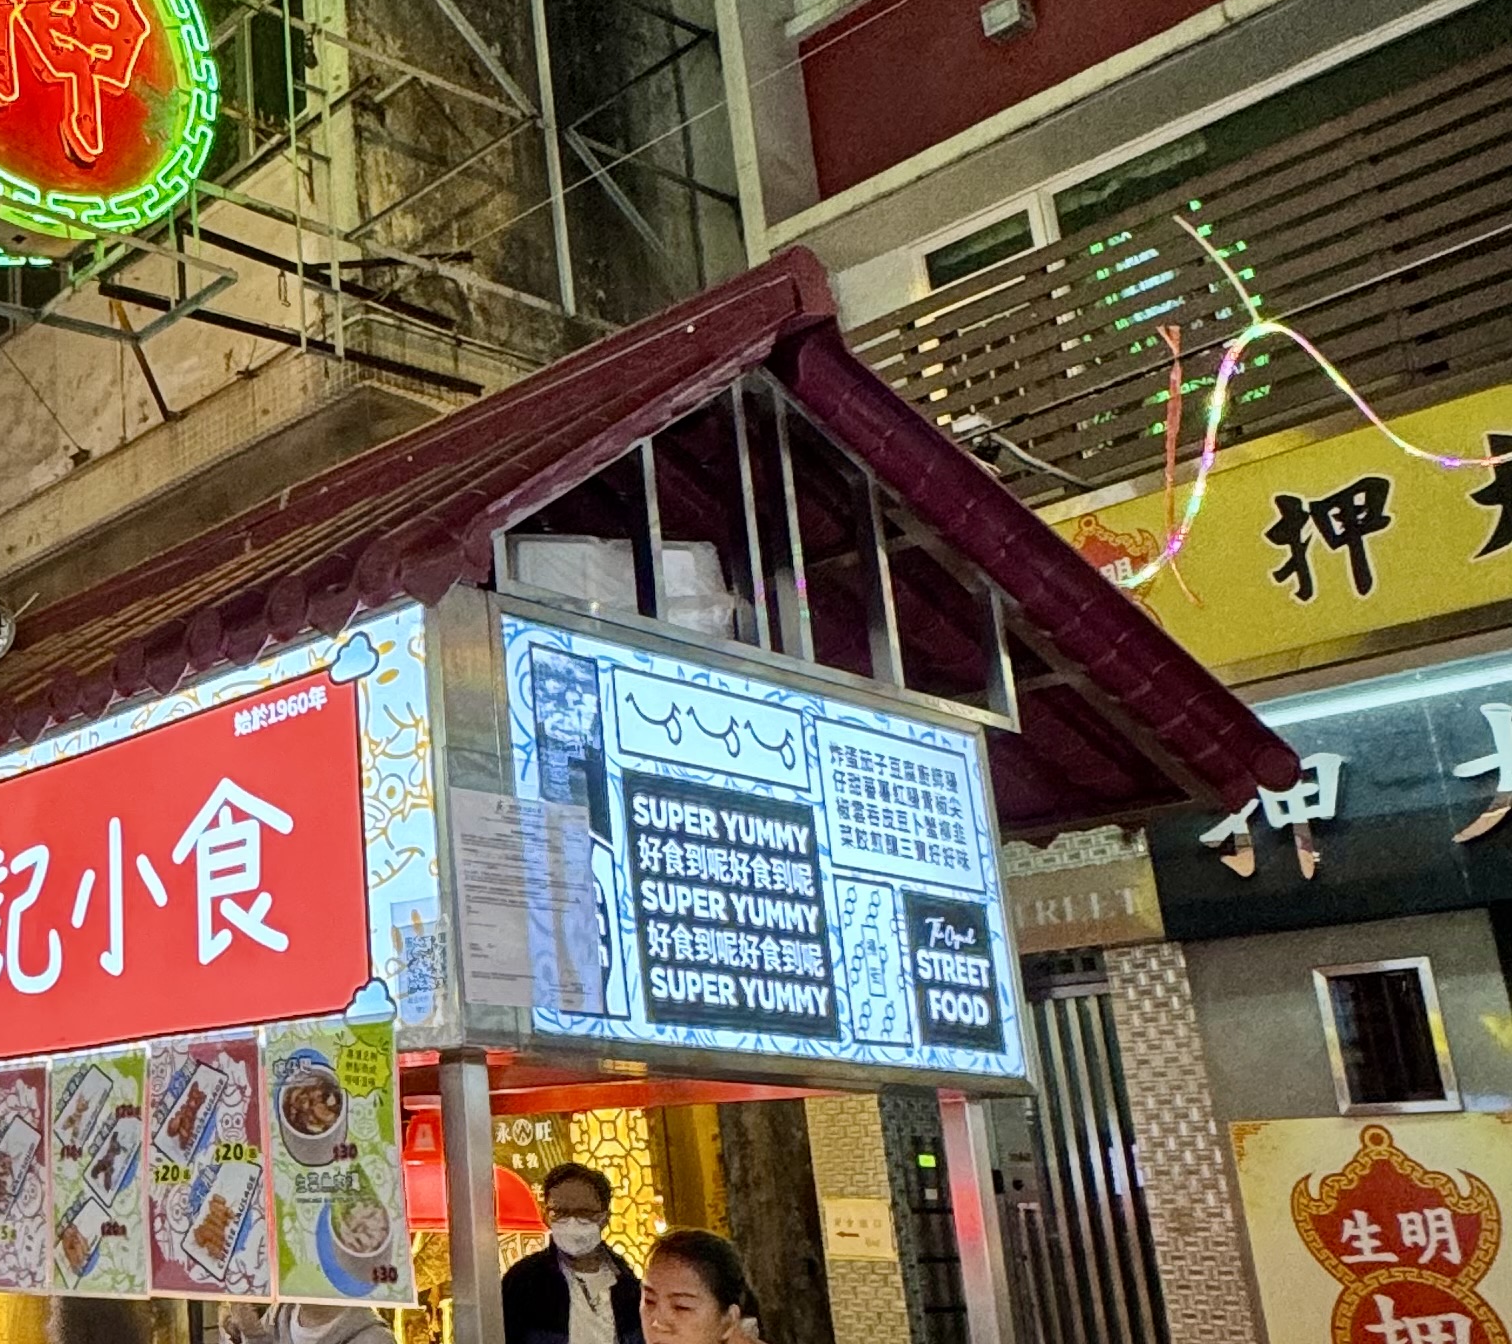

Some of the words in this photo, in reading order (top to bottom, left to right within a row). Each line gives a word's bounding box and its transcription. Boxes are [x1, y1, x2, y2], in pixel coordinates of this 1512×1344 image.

[234, 685, 327, 736] 始於1960年
[633, 794, 719, 839] SUPER
[720, 810, 809, 854] YUMMY
[637, 833, 816, 897] 好食到呢好食到呢
[641, 880, 729, 921] SUPER
[730, 892, 819, 934] YUMMY
[647, 919, 825, 978] 好食到呢好食到呢
[916, 948, 991, 989] STREET
[650, 966, 739, 1007] SUPER
[739, 976, 829, 1017] YUMMY
[927, 988, 990, 1027] FOOD
[155, 1164, 180, 1182] $20
[215, 1143, 245, 1163] $20
